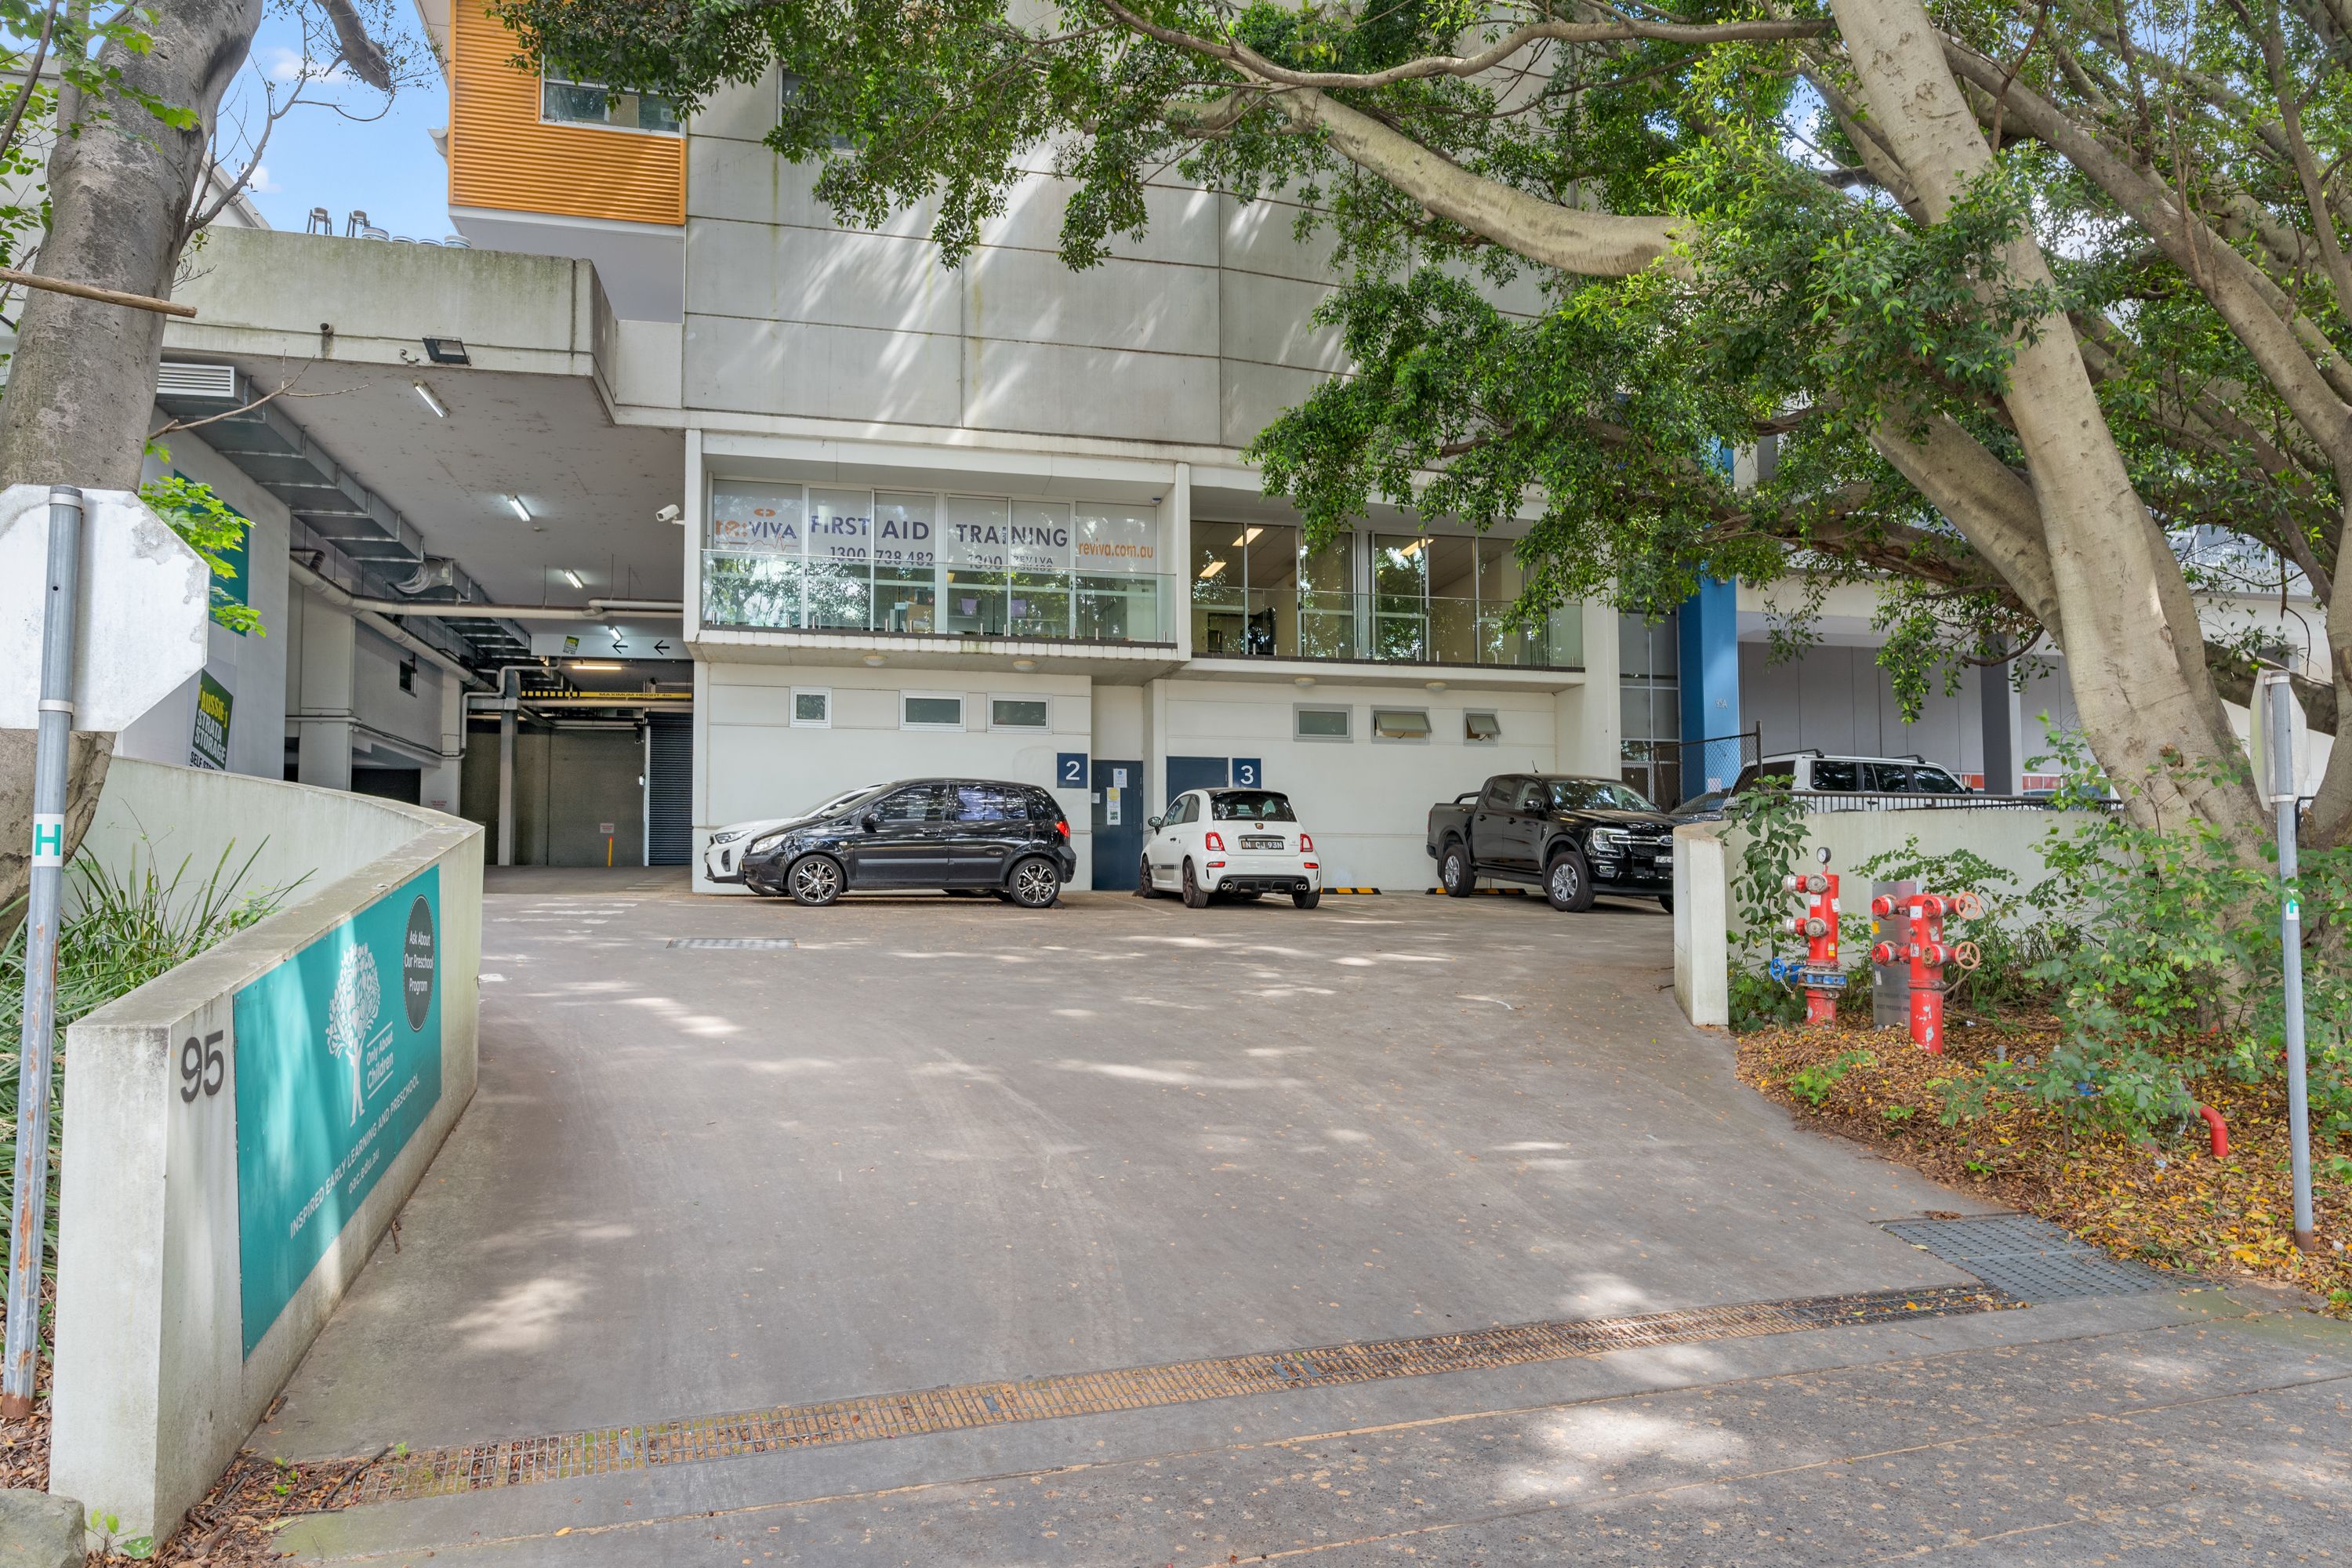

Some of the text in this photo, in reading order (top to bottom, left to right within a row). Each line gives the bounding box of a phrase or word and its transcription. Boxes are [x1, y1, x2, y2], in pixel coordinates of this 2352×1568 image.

[811, 515, 1068, 547] FIRST AID TRAINING
[830, 546, 934, 566] 1300 738 482
[1079, 538, 1154, 559] reviva.com.au
[201, 690, 225, 721] AUSSIE
[197, 708, 223, 743] STRATA
[194, 726, 227, 764] STORAGE
[1065, 760, 1080, 781] 2
[1240, 764, 1254, 785] 3
[35, 824, 61, 856] H
[418, 932, 430, 946] About
[405, 954, 434, 969] Our Preschool
[409, 978, 428, 995] Program
[366, 1031, 393, 1066] Only About
[180, 1029, 224, 1103] 95
[367, 1051, 394, 1090] Children
[290, 1073, 419, 1239] INSPIRED EARLY LEARNING AND PRESCHOOL
[349, 1148, 379, 1194] oac.edu.au
